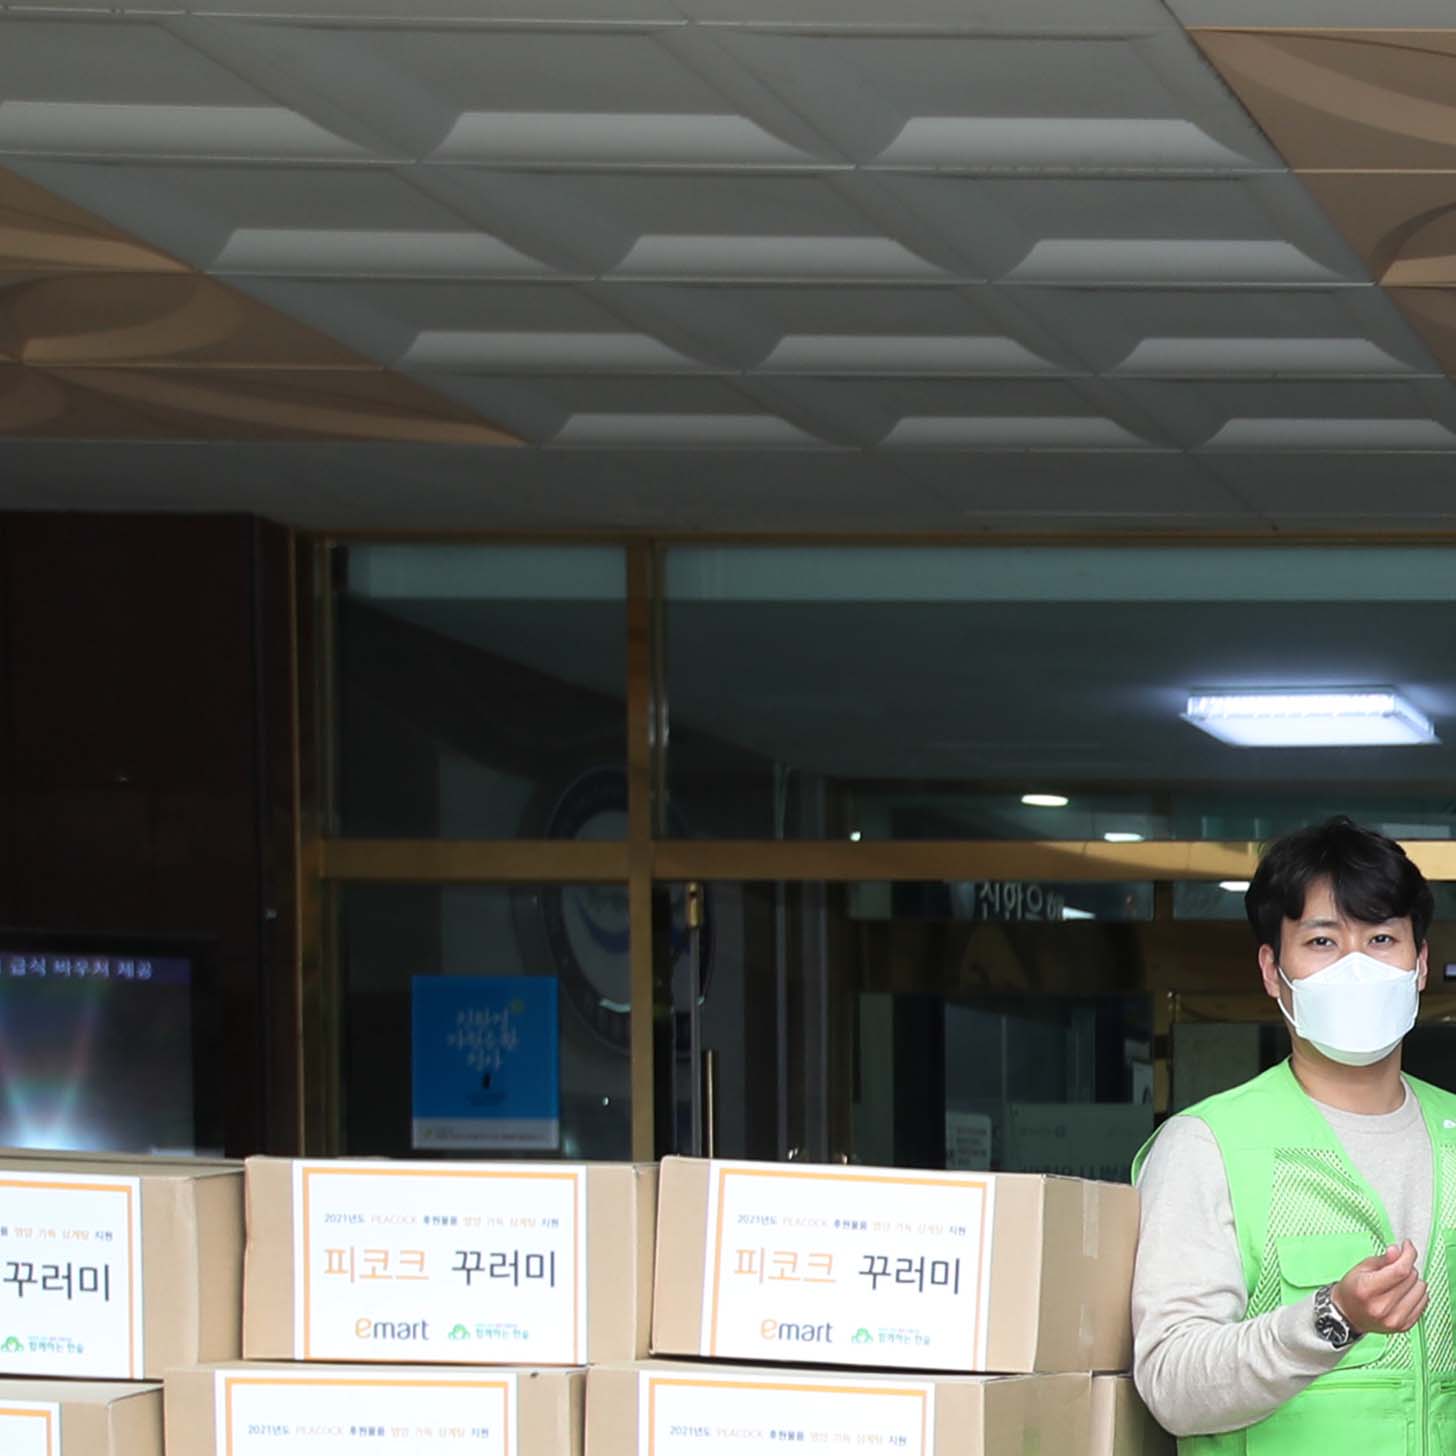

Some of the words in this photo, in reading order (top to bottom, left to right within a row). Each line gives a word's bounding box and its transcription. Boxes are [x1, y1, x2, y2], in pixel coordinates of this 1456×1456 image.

[10, 957, 46, 977] 급식
[53, 959, 110, 978] 바우처
[117, 960, 152, 979] 제공
[324, 1213, 364, 1224] 2021년도
[325, 1247, 428, 1283] 피코크
[451, 1249, 555, 1288] 꾸러미
[735, 1248, 834, 1283] 피코크
[858, 1255, 960, 1295] 꾸러미
[354, 1315, 430, 1341] emart
[760, 1316, 833, 1343] emart
